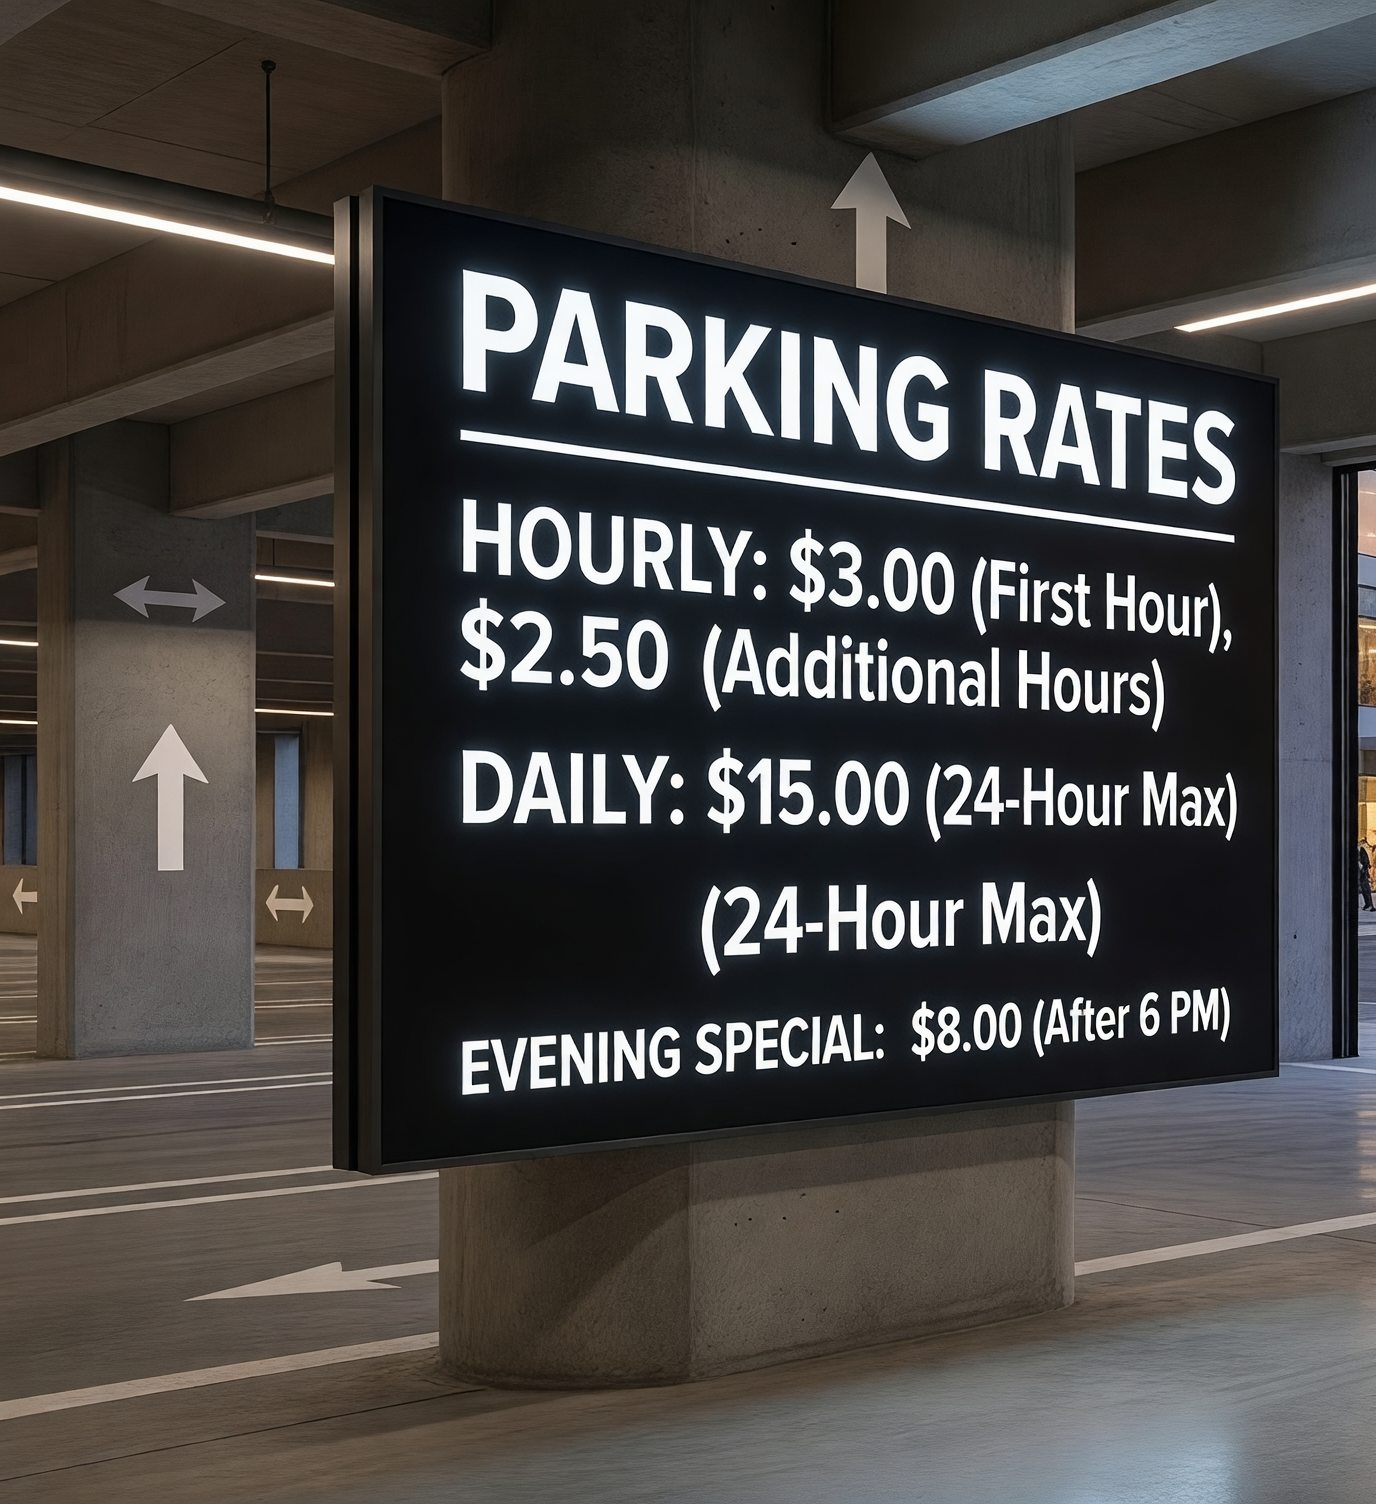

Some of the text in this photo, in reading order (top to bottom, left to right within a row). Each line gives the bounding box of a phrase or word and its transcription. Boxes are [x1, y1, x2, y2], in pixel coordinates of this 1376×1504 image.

[462, 268, 1236, 506] PARKING RATES
[462, 498, 1232, 654] HOURLY: $3.00 (First Hour),
[459, 597, 1165, 733] $2.50 (Additional Hours)
[462, 747, 1238, 843] DAILY: $15.00 (24-Hour Max)
[701, 877, 1102, 977] (24-Hour Max)
[461, 986, 1231, 1096] EVENING SPECIAL: $8.00 (After 6 PM)
